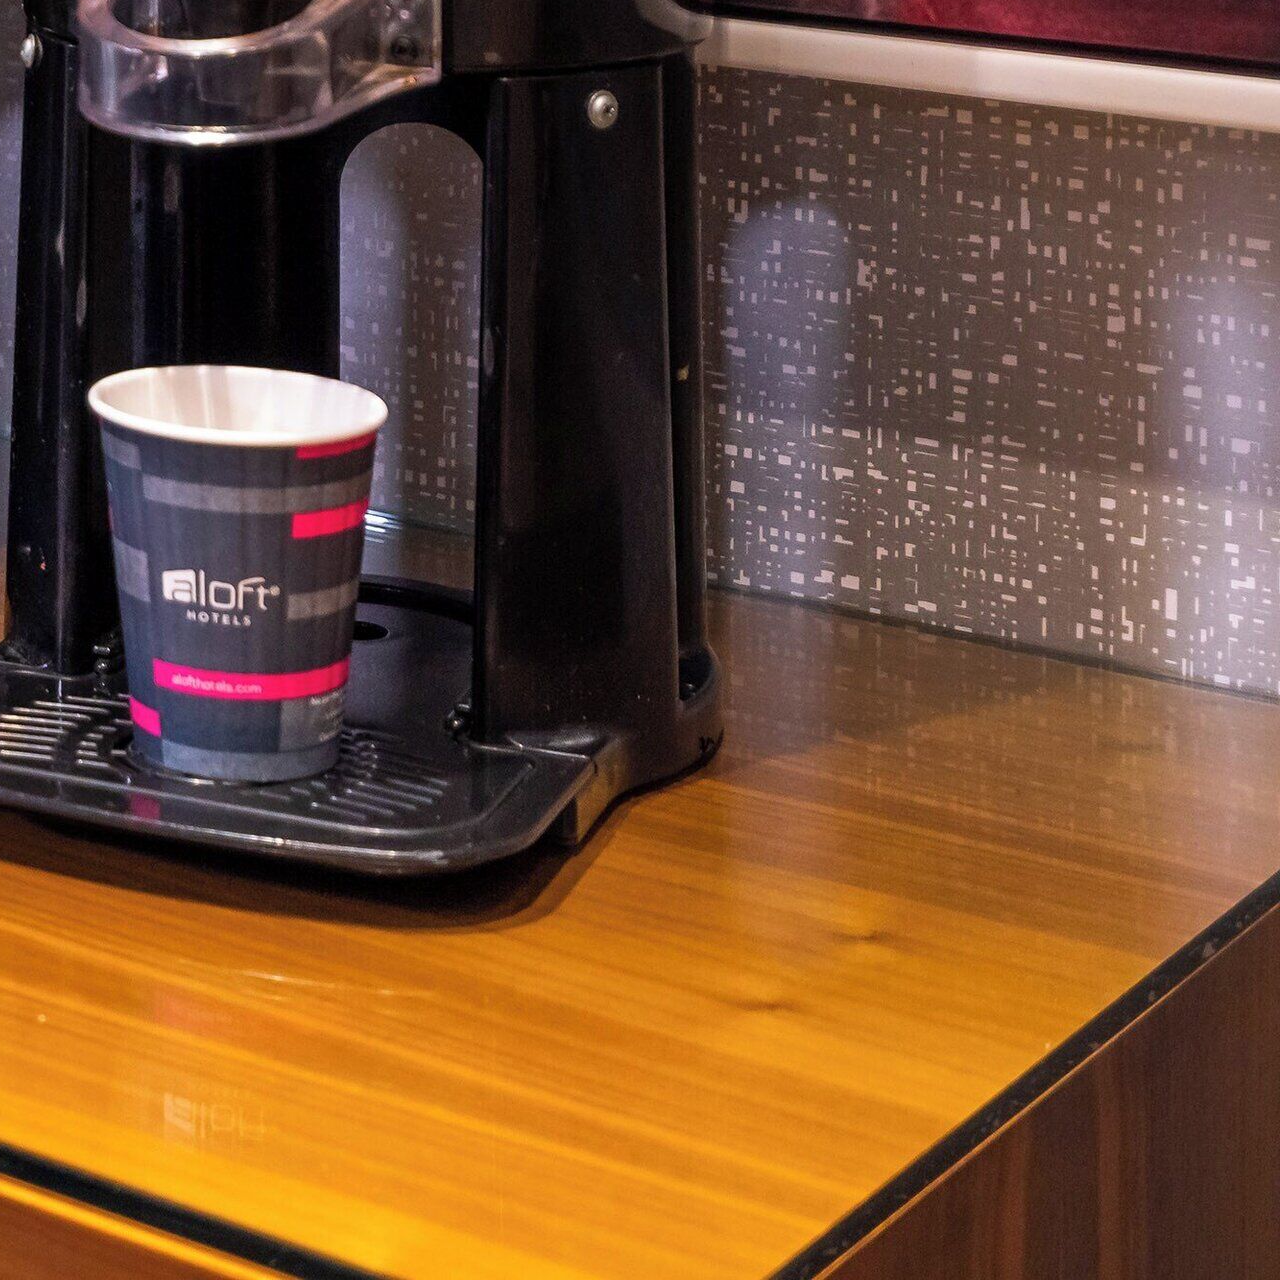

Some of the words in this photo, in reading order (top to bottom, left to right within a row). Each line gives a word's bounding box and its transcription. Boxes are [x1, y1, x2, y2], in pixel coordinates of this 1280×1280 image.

[162, 569, 270, 611] aloft
[186, 609, 252, 627] HOTELS
[171, 675, 263, 694] alofthotels.com
